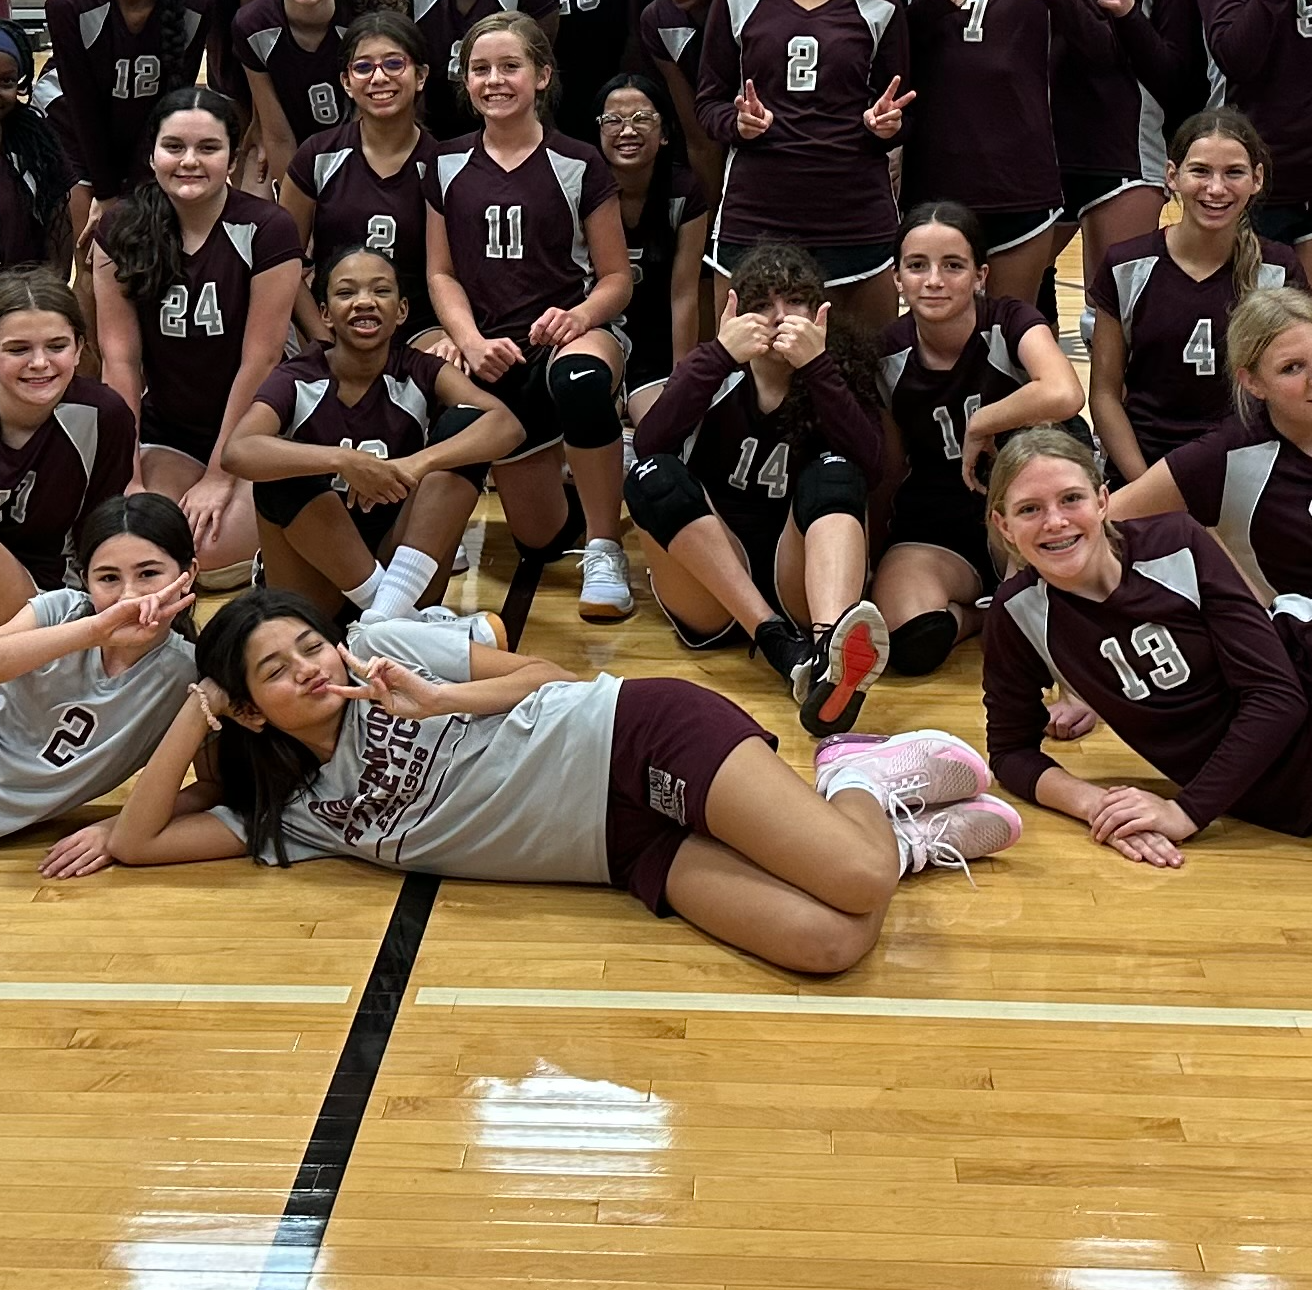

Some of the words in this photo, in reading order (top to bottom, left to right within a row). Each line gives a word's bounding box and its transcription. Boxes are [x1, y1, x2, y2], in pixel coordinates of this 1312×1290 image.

[113, 55, 161, 99] 12
[786, 36, 819, 92] 2
[308, 82, 339, 125] 8
[485, 205, 524, 259] 11
[160, 281, 224, 338] 24
[1183, 318, 1216, 376] 4
[728, 437, 790, 498] 14
[1100, 621, 1190, 701] 13
[36, 704, 100, 768] 2
